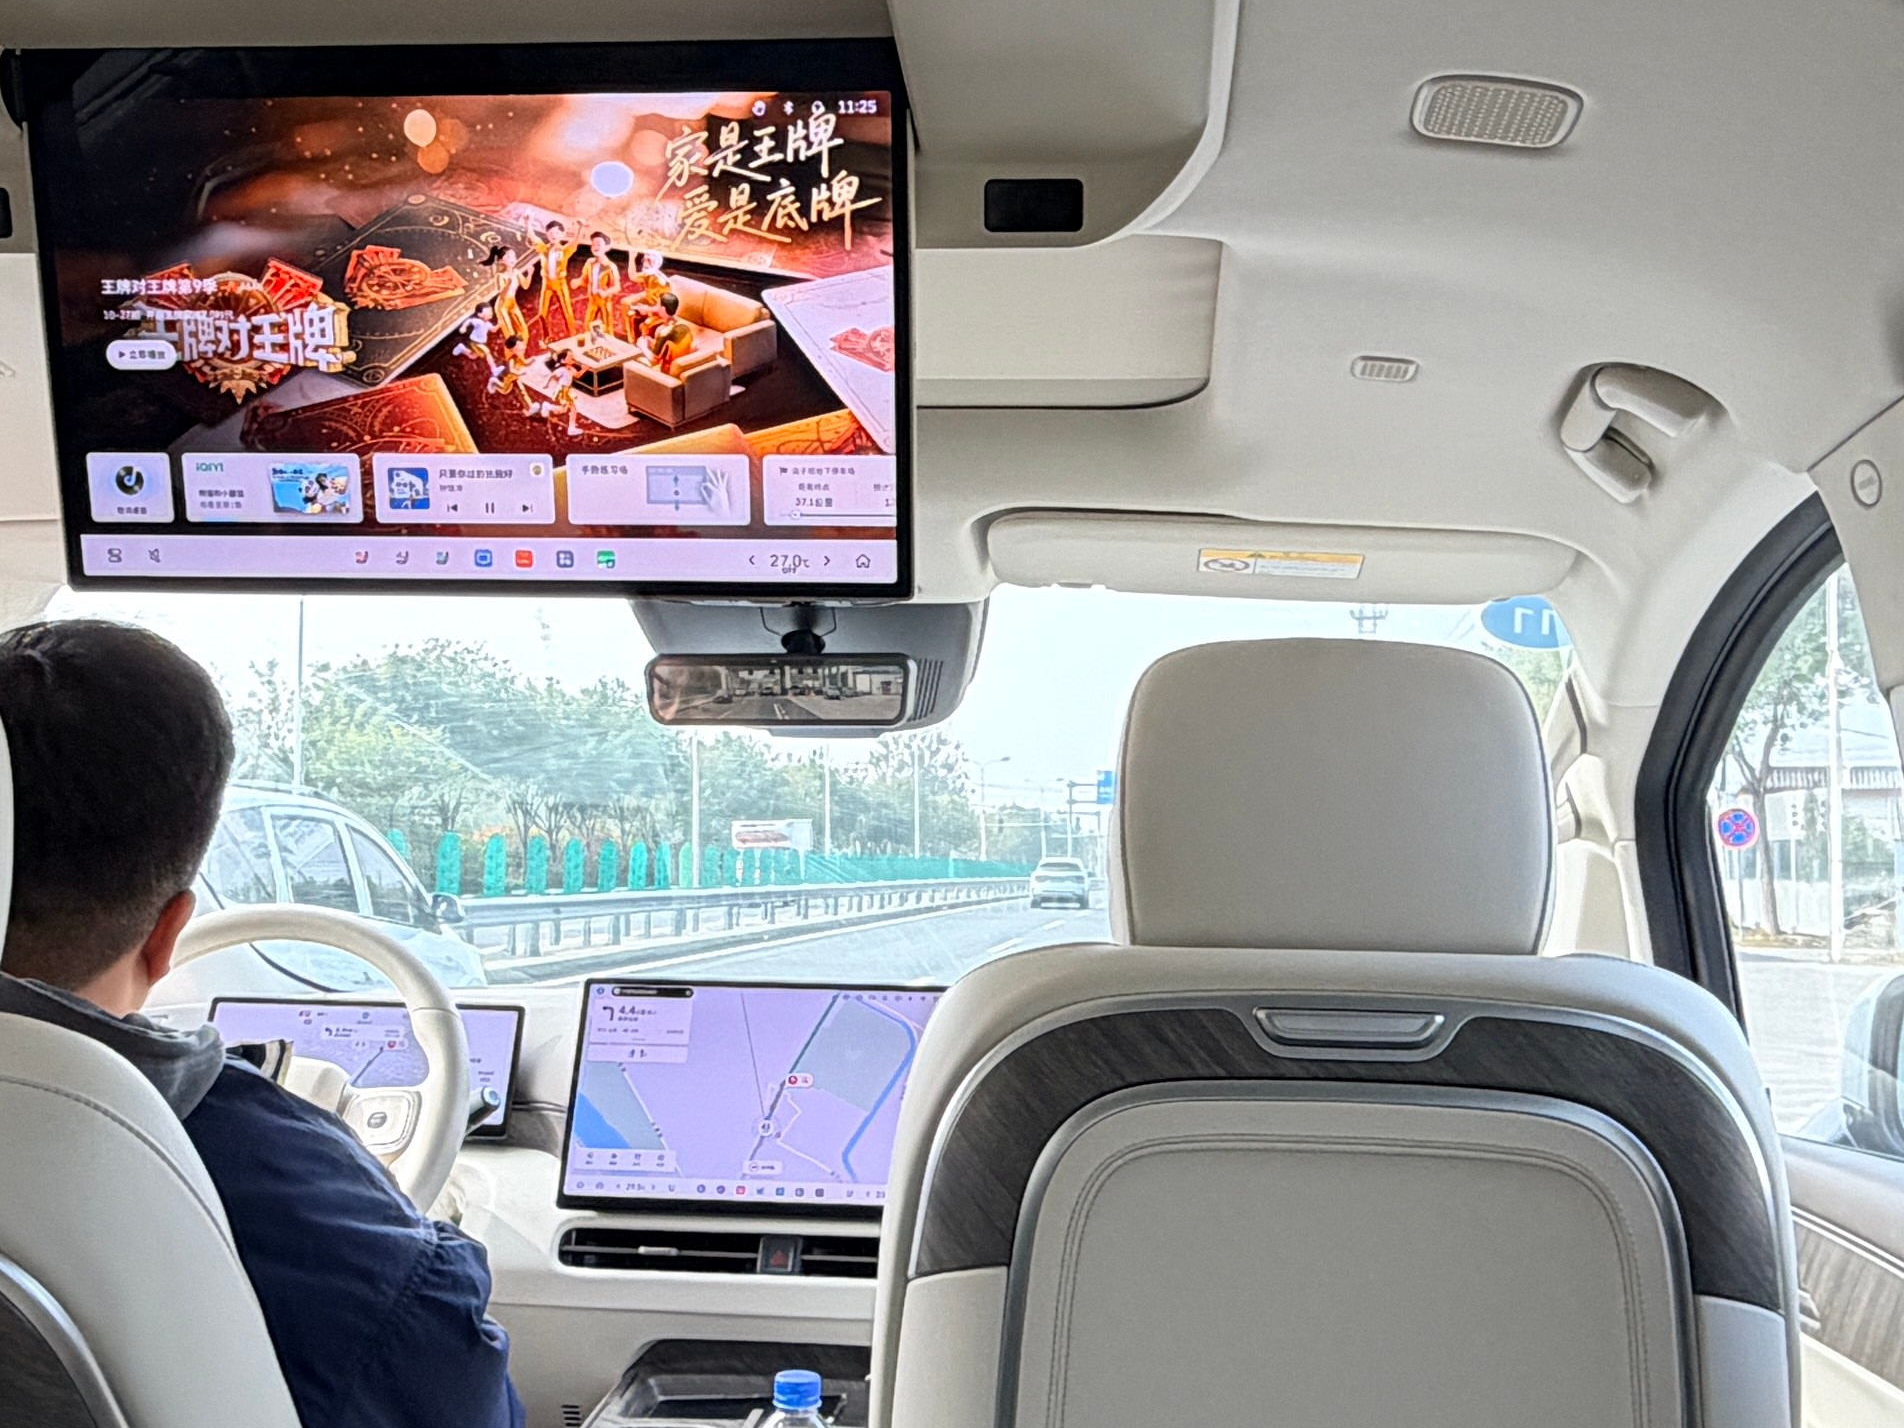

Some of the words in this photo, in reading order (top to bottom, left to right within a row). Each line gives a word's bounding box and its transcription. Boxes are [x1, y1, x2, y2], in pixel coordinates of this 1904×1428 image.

[837, 99, 878, 114] 11:25
[653, 111, 844, 205] 家是王牌
[670, 169, 883, 251] 爱是底牌
[100, 278, 218, 295] 王牌对王牌第9季
